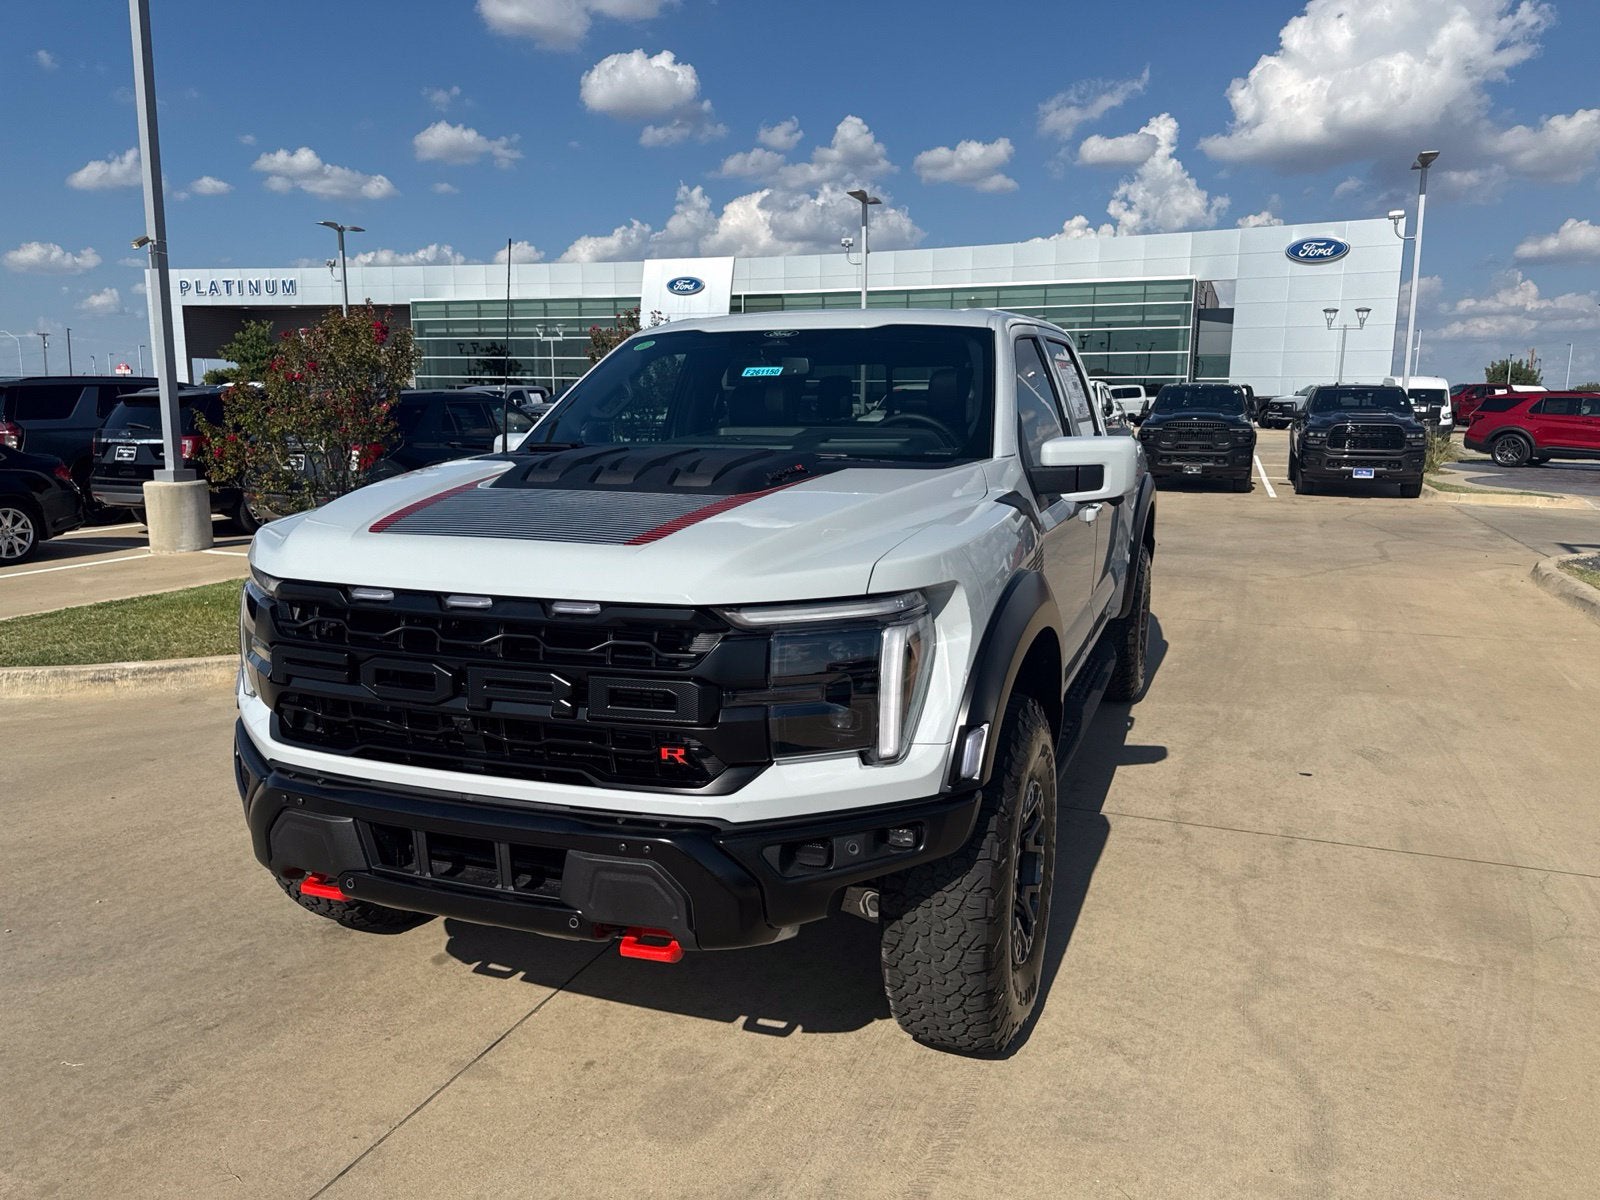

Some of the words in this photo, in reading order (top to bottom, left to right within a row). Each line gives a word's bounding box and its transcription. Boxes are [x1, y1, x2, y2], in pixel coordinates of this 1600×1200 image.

[1298, 242, 1336, 257] Ford
[179, 279, 297, 296] PLATINUM
[271, 642, 700, 723] FORD
[661, 747, 689, 765] R
